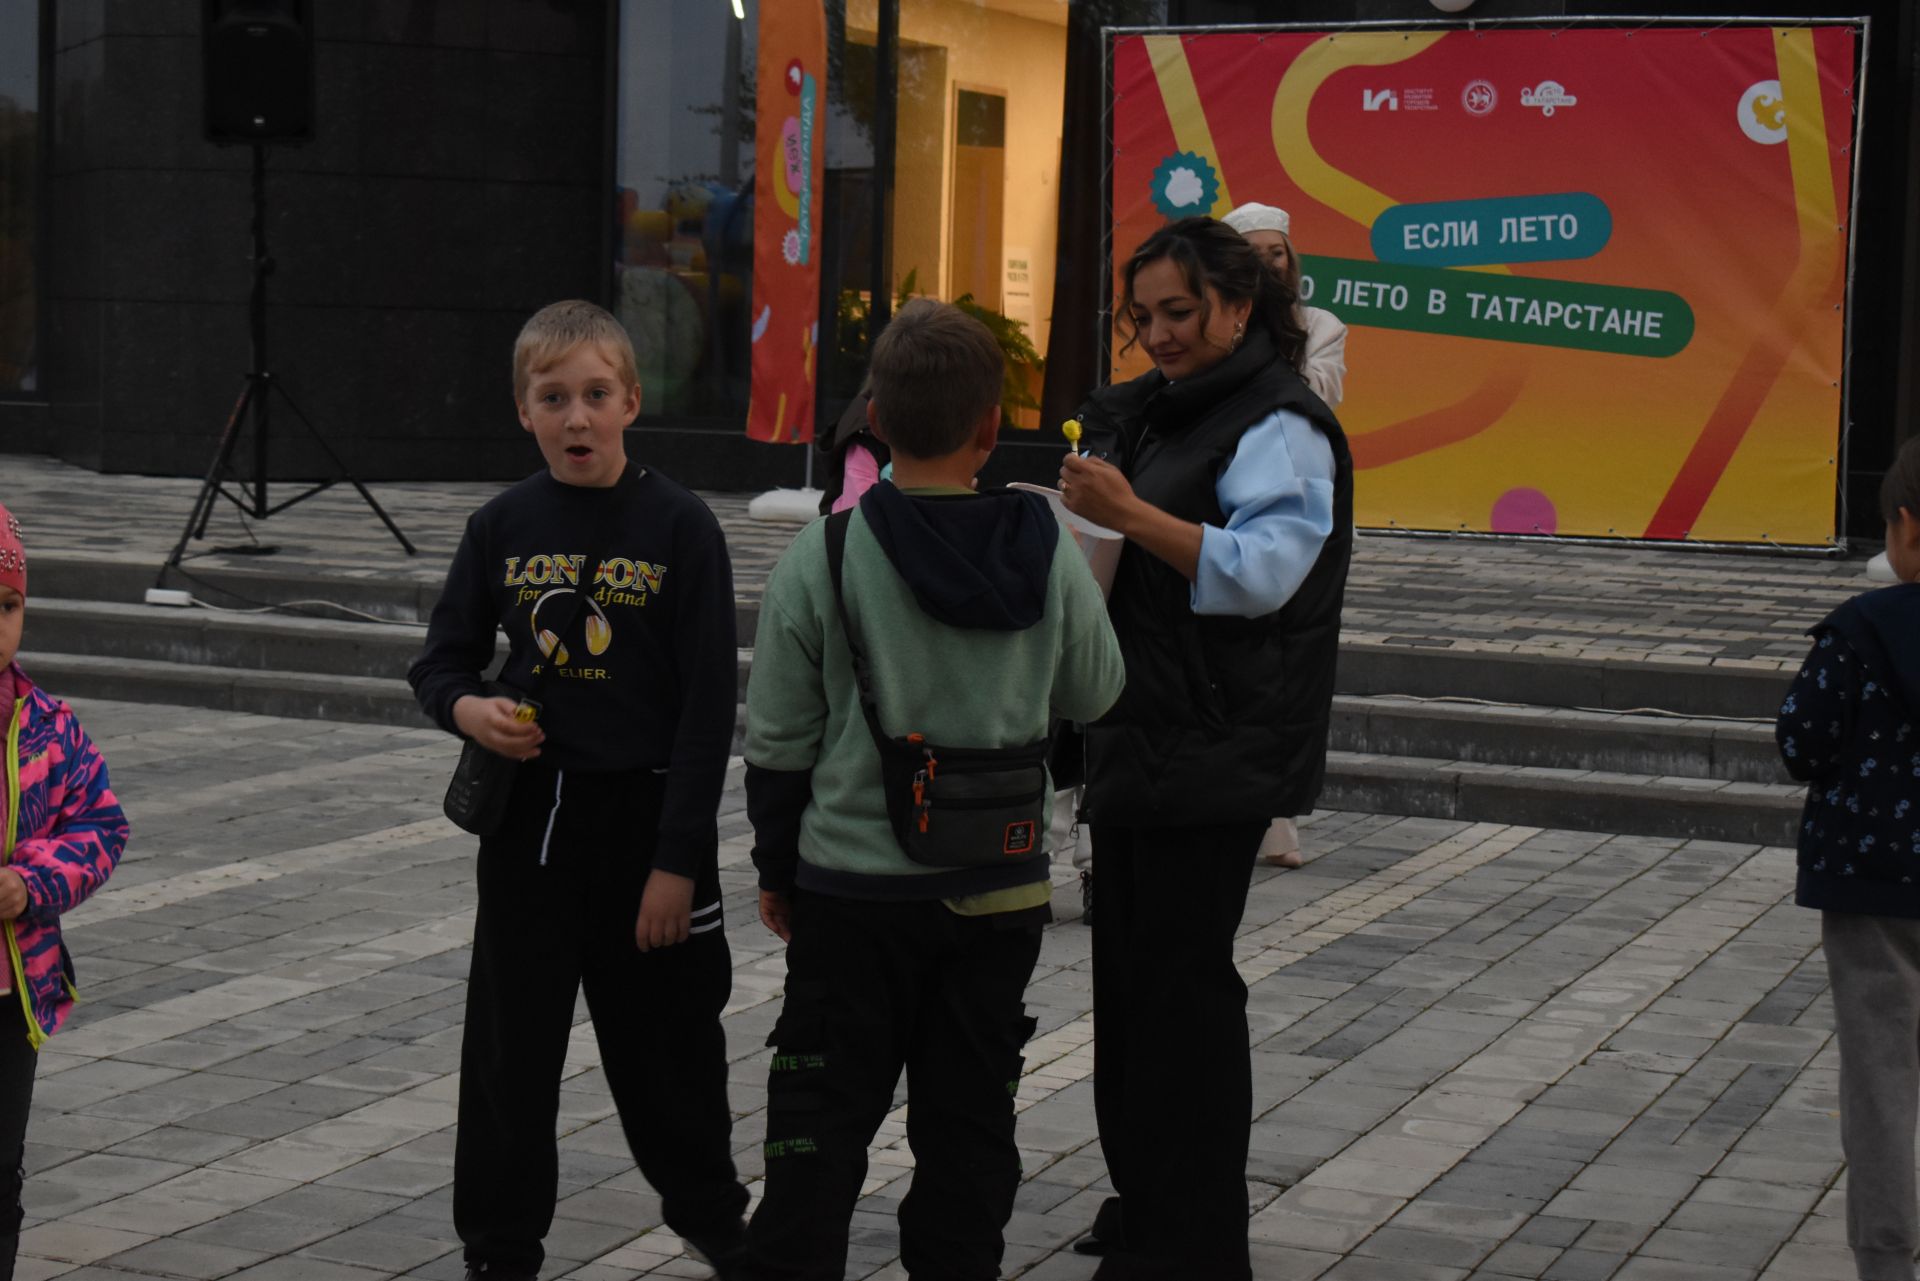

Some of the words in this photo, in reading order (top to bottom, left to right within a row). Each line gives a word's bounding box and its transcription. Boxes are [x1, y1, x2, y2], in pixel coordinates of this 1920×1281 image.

[1403, 220, 1479, 250] ЕСЛИ
[1499, 213, 1578, 245] ЛЕТО
[1300, 275, 1315, 302] О
[1332, 278, 1409, 312] ЛЕТО
[1427, 288, 1447, 315] В
[1466, 292, 1664, 339] ТАТАРСТАНЕ
[531, 664, 612, 680] AELIER.
